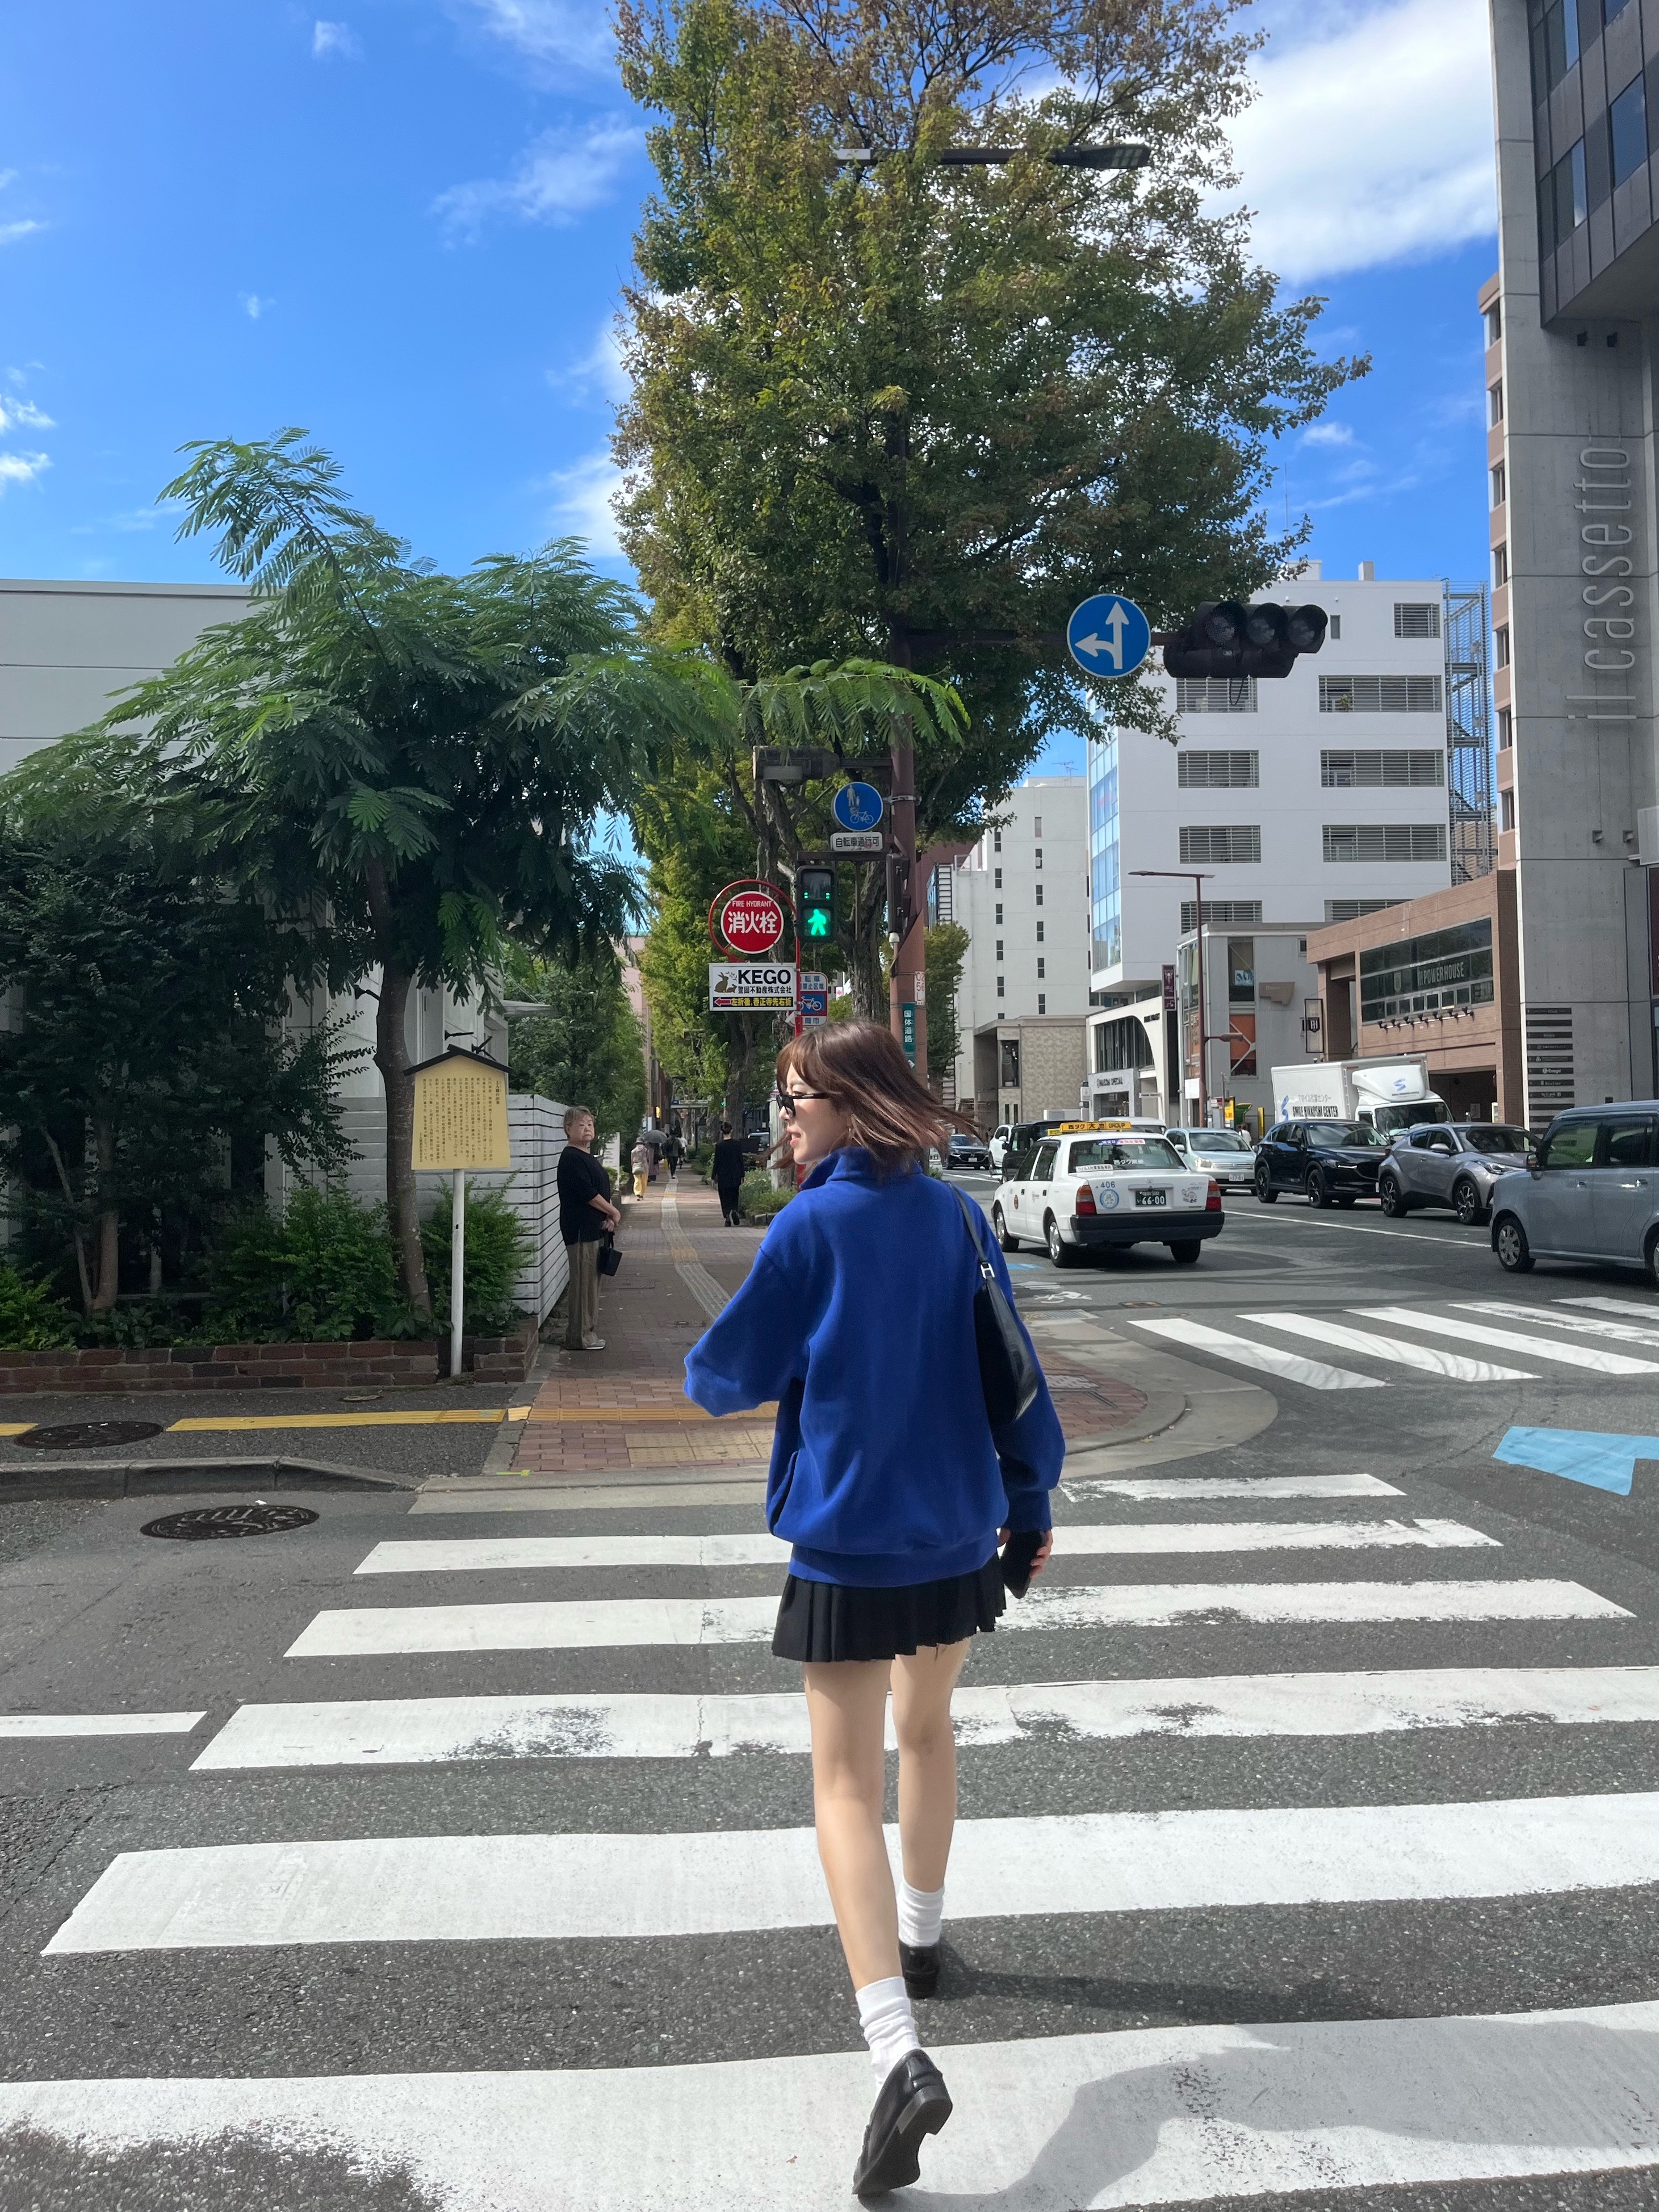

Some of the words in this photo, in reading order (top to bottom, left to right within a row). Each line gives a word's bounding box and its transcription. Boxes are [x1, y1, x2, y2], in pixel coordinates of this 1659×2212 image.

[1573, 447, 1636, 671] cassetto
[728, 911, 778, 934] 消火栓
[738, 969, 791, 984] KEGO
[1424, 962, 1464, 985] POWERHOUSE
[738, 986, 792, 994] 警固不動産株式会社
[904, 1010, 912, 1042] 国体道路
[1142, 1196, 1164, 1205] 66-00
